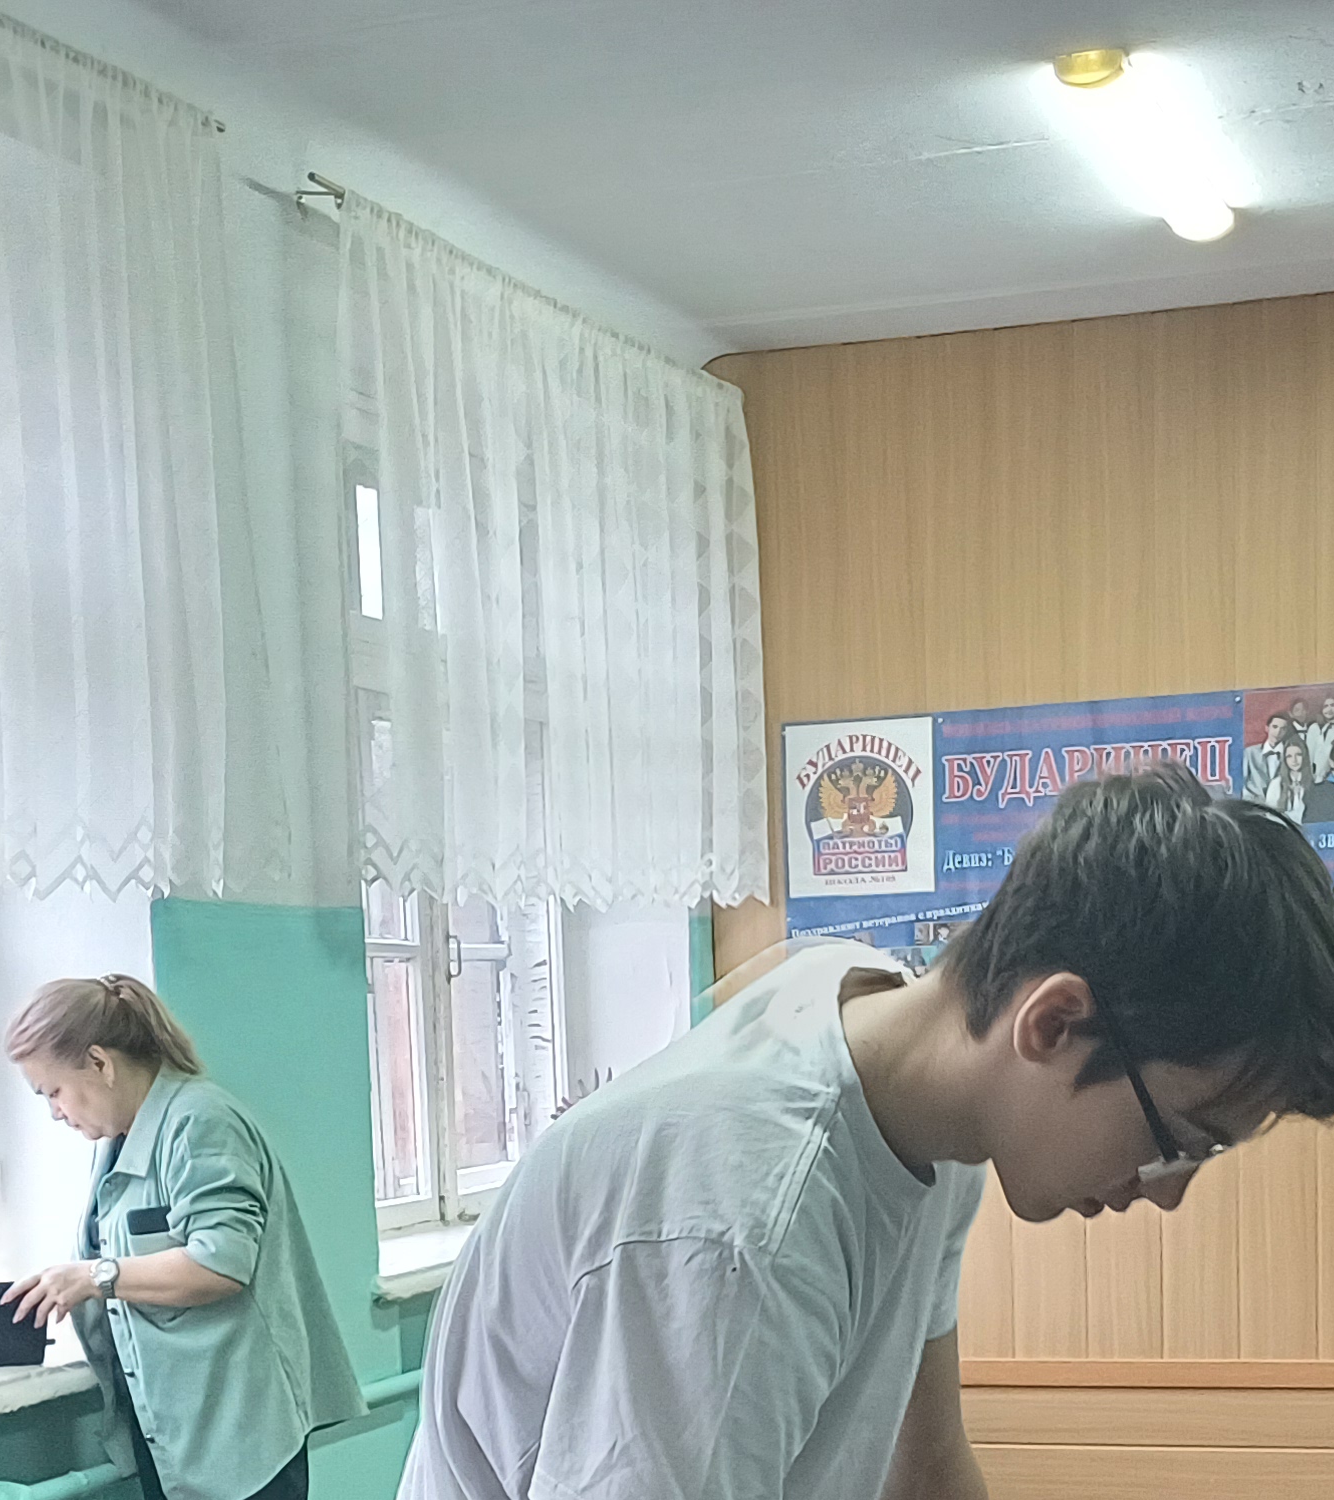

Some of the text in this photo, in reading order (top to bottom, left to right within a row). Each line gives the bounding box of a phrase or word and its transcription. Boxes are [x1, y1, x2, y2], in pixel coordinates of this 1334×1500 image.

[796, 734, 922, 790] БУДАРИНЕЦ
[820, 837, 900, 852] ПАТРИОТЫ
[821, 854, 901, 872] РОССИИ
[942, 849, 992, 873] Девиз:
